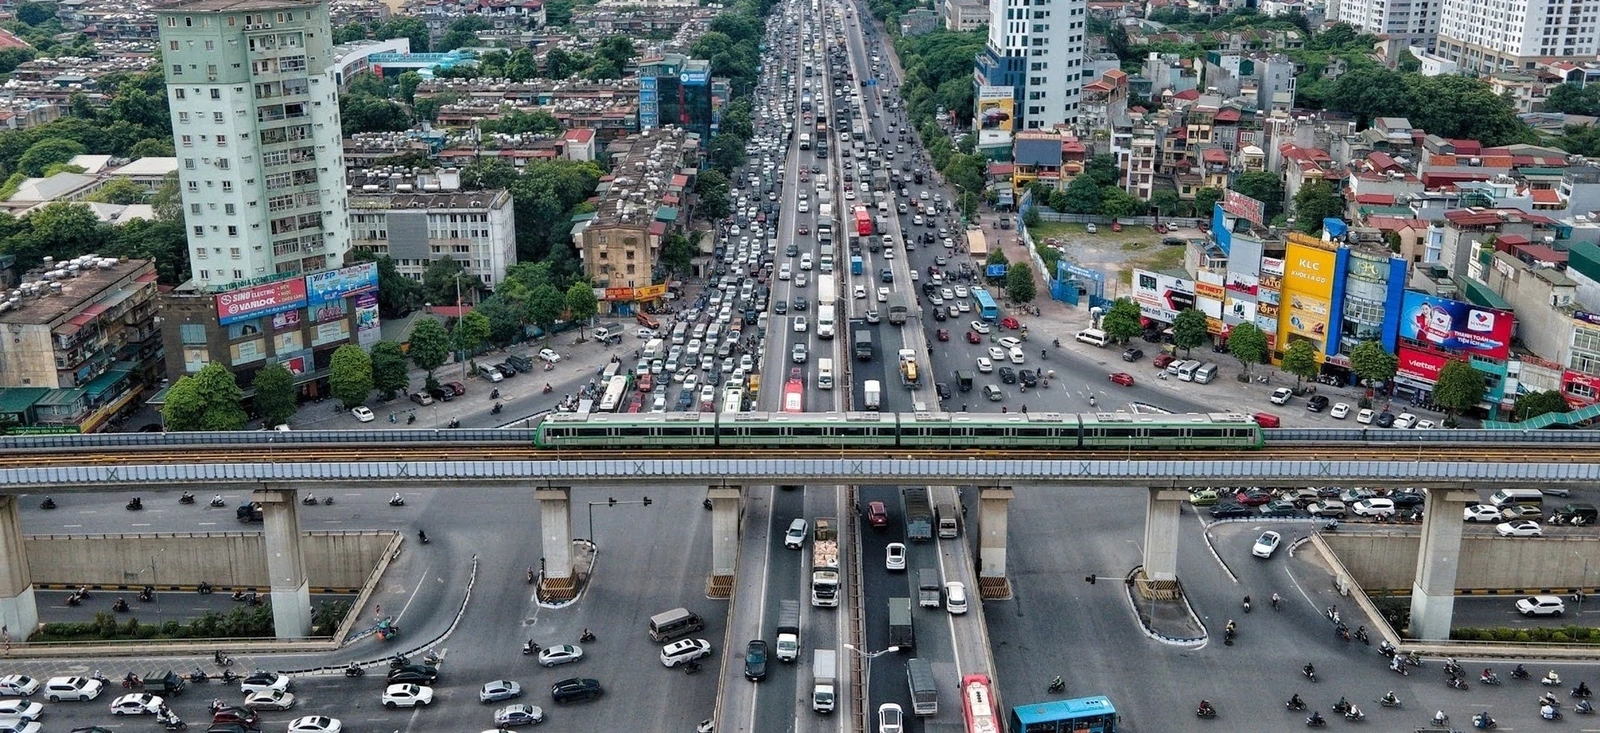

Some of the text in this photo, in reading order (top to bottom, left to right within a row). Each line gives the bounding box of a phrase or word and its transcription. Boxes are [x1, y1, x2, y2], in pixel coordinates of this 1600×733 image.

[232, 289, 275, 302] SINO ELECTRIC
[239, 297, 276, 311] VANLOCK
[1454, 331, 1472, 339] THANH
[1472, 334, 1489, 342] TOÁN
[1408, 360, 1437, 372] viettel
